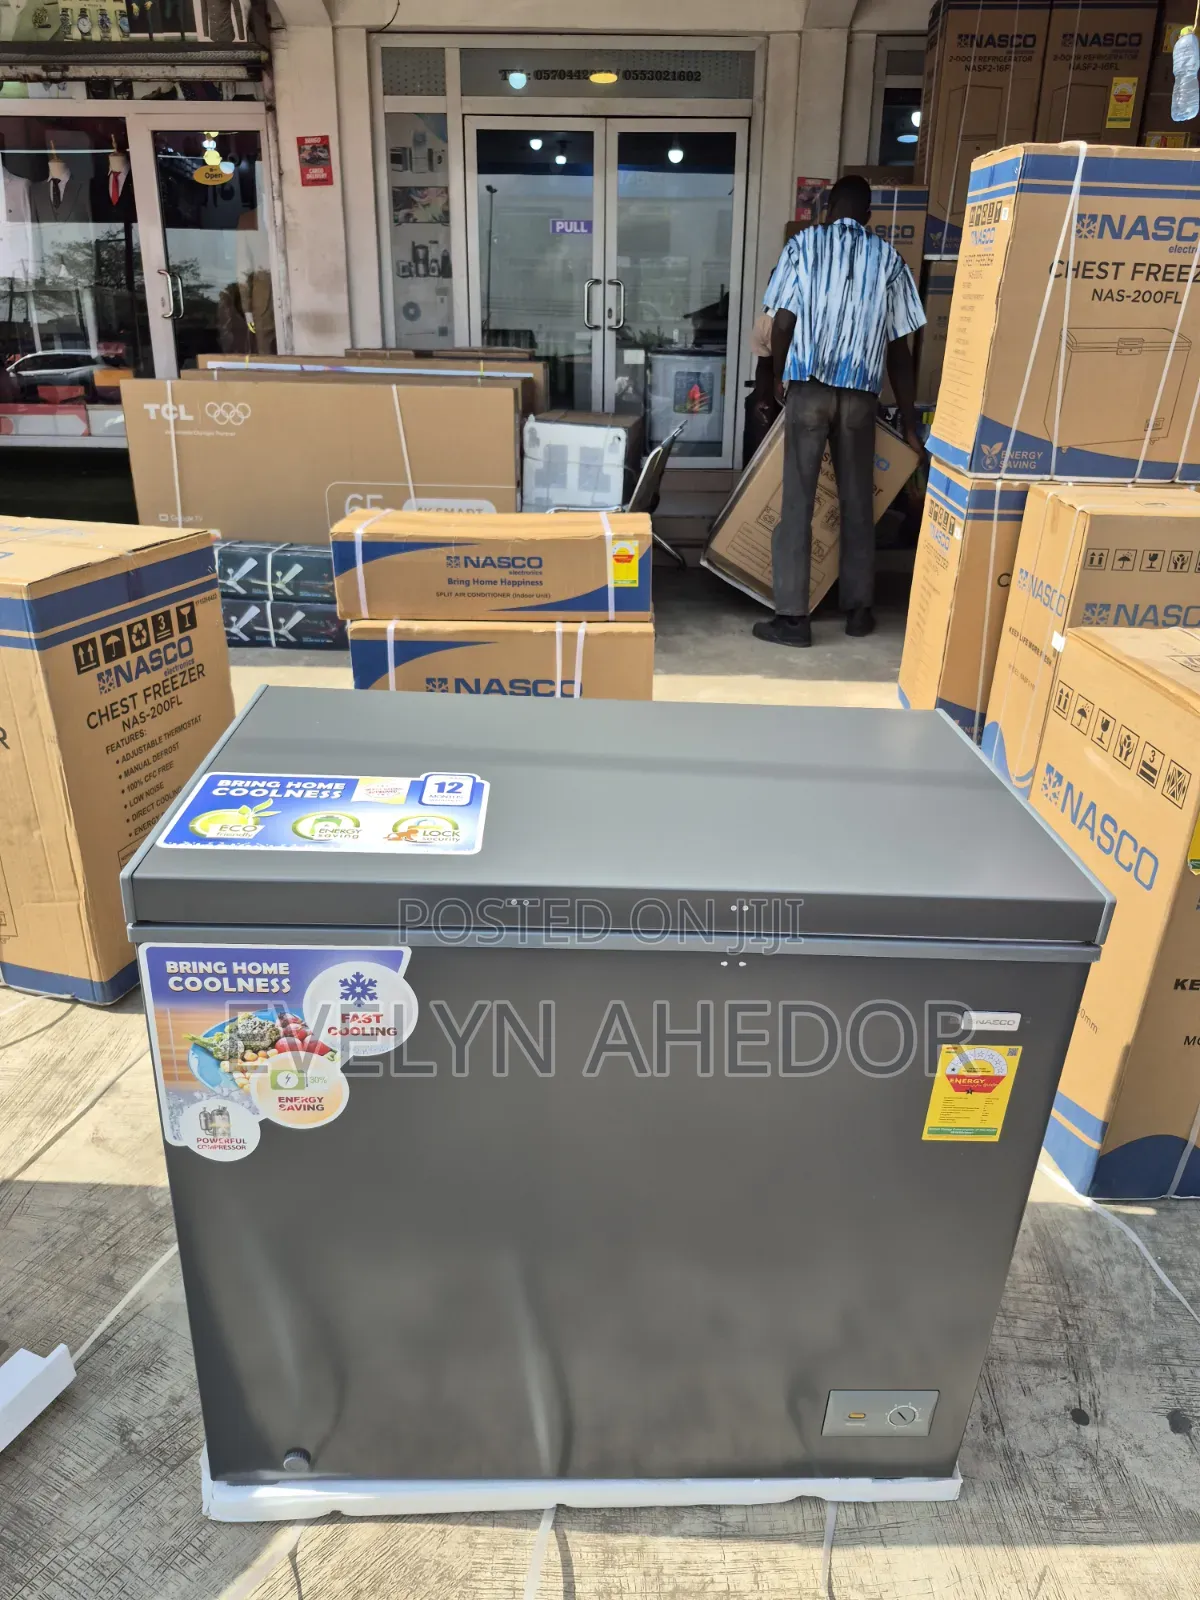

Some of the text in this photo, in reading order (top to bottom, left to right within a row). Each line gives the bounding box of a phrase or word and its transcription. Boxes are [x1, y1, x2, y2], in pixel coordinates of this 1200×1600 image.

[969, 33, 1037, 48] NASCO
[1075, 32, 1143, 47] NASCO
[555, 221, 588, 233] PULL
[1048, 260, 1125, 281] CHEST
[1091, 288, 1184, 305] NAS-200FL
[143, 403, 194, 420] TCL
[464, 555, 543, 569] NASCO
[447, 577, 543, 588] Bring Home Happiness
[1028, 574, 1067, 618] NASCO
[113, 635, 194, 688] NASCO
[163, 658, 195, 677] electronics
[86, 663, 206, 729] CHEST FREEZER
[453, 677, 584, 698] NASCO
[121, 694, 183, 732] NAS-200FL
[105, 729, 148, 755] FEATURES:
[121, 714, 202, 764] ADJUSTABLE THERMOSTAT
[123, 741, 180, 778] MANUAL DEFROST
[126, 760, 175, 792] 100% CFC FREE
[217, 779, 346, 790] BRING HOME
[129, 781, 165, 808] LOW NOISE
[211, 787, 343, 799] COOLNESS
[434, 781, 464, 794] 12
[131, 803, 155, 822] DIRECT
[218, 824, 258, 832] ECO
[1061, 781, 1160, 892] NASCO
[165, 960, 291, 976] BRING HOME
[167, 976, 293, 994] COOLNESS
[340, 1012, 384, 1025] FAST
[1078, 1007, 1099, 1035] 0mm
[327, 1026, 398, 1037] COOLING
[308, 1075, 328, 1084] 30%
[278, 1096, 325, 1104] ENERGY
[278, 1103, 326, 1112] SAVING
[196, 1137, 248, 1145] POWERFUL
